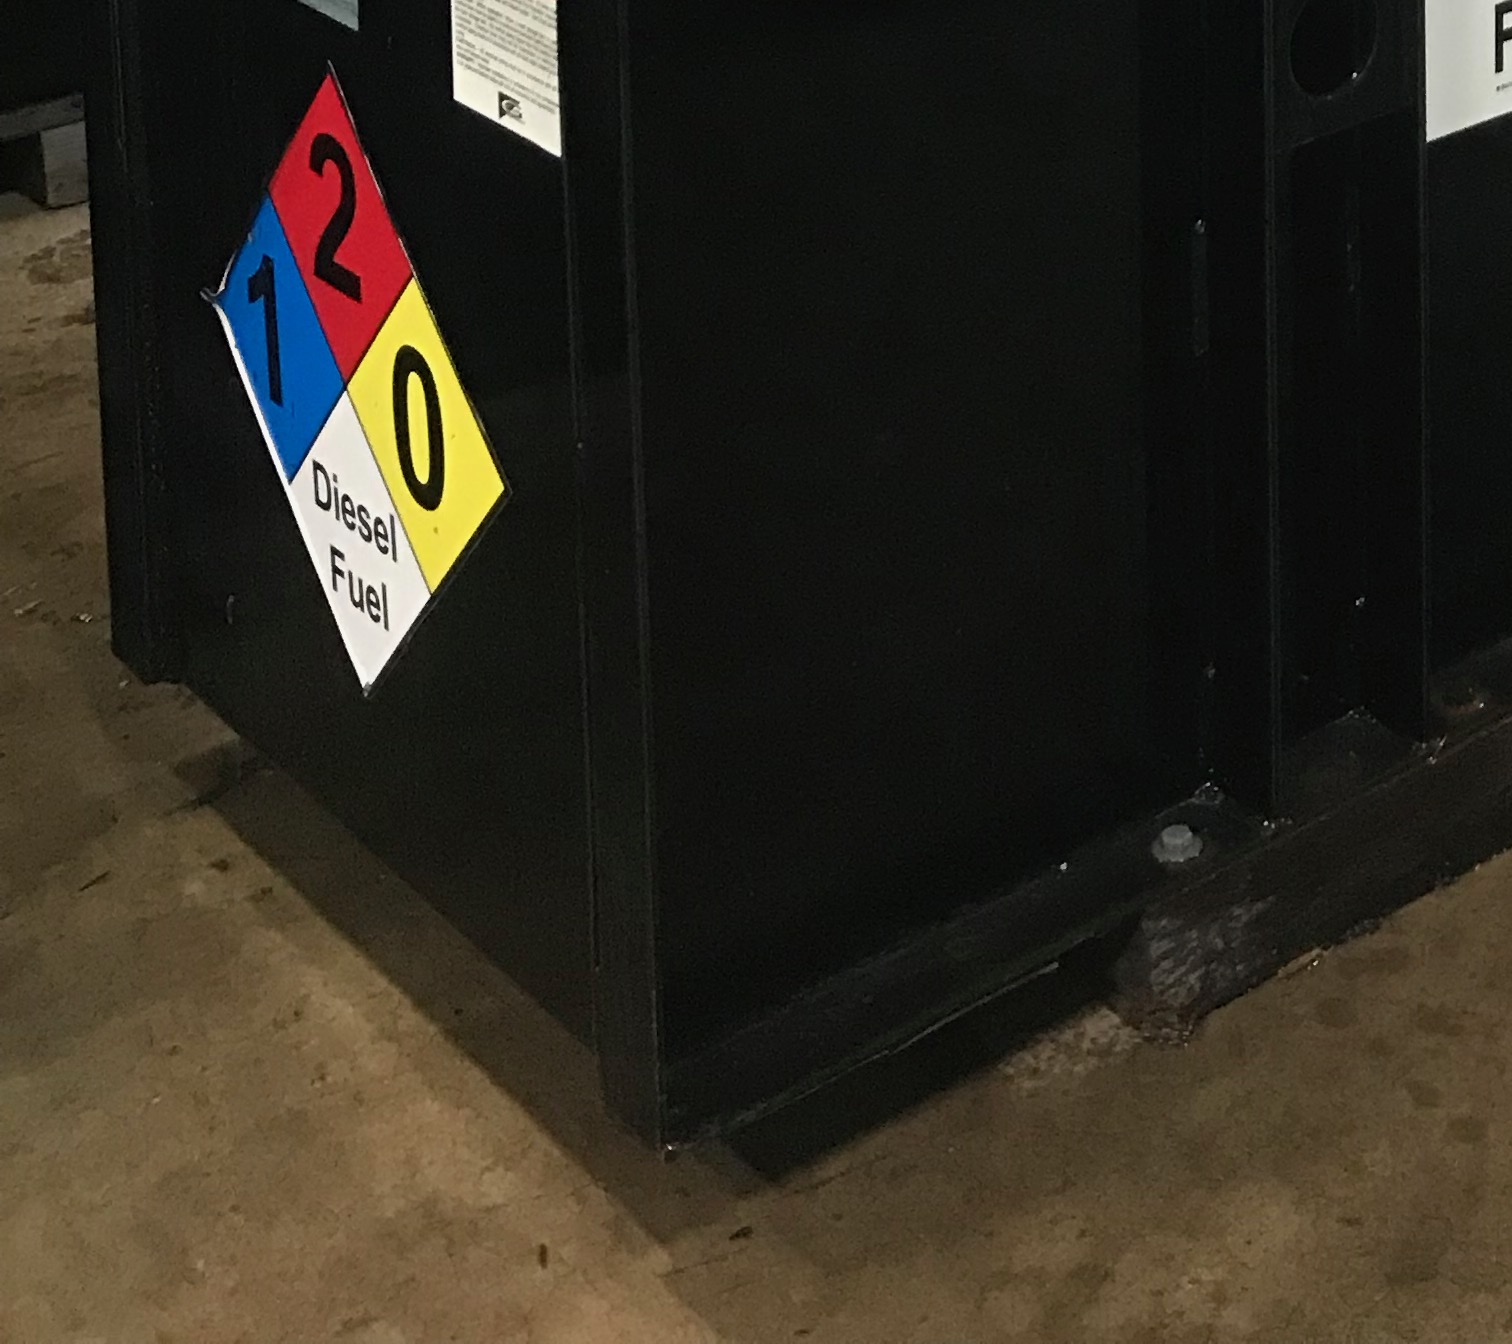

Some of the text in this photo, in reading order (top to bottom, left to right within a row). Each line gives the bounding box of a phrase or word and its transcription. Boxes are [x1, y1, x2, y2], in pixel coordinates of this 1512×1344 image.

[309, 132, 362, 304] 2
[247, 254, 283, 408] 1
[392, 344, 446, 511] 0
[312, 459, 398, 563] Diesel
[329, 545, 390, 631] Fuel
